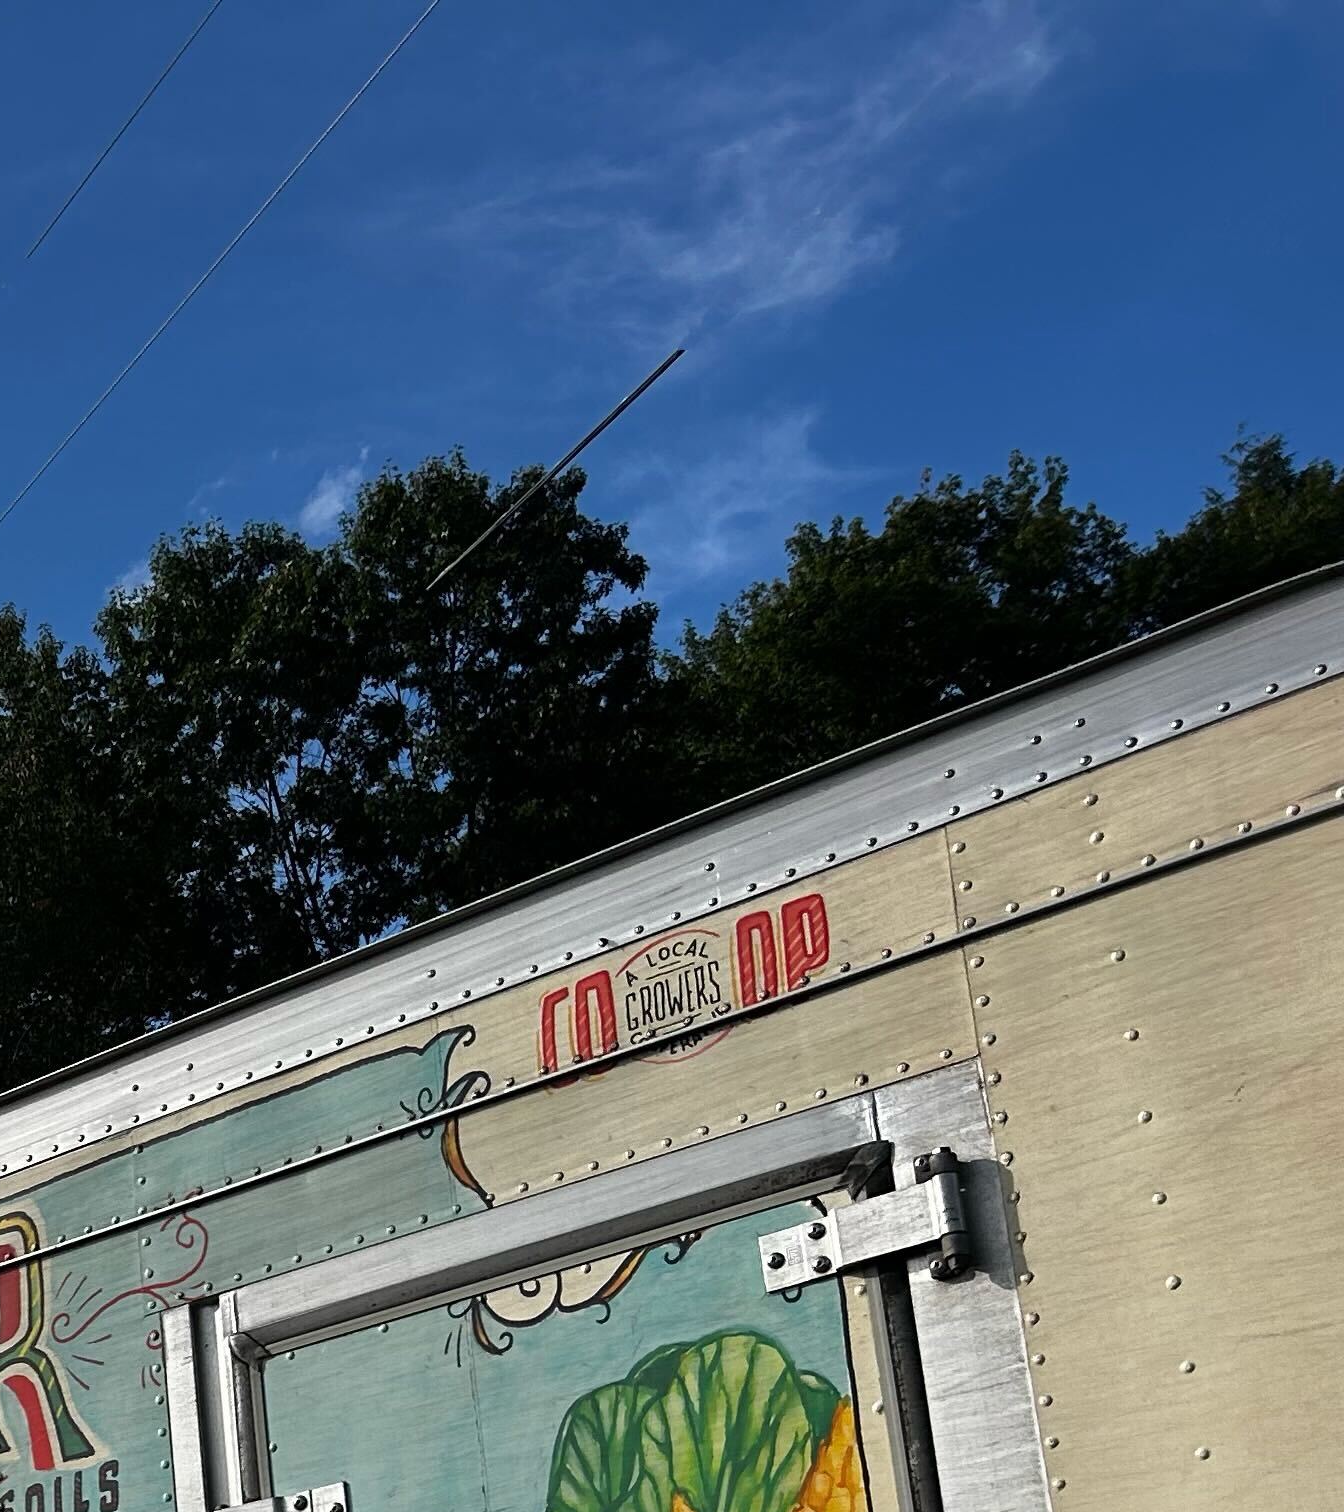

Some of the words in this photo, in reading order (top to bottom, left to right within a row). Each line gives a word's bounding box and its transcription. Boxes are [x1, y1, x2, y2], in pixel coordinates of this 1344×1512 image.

[625, 969, 638, 988] A
[645, 938, 710, 968] LOCAL
[625, 960, 721, 1031] GROWERS
